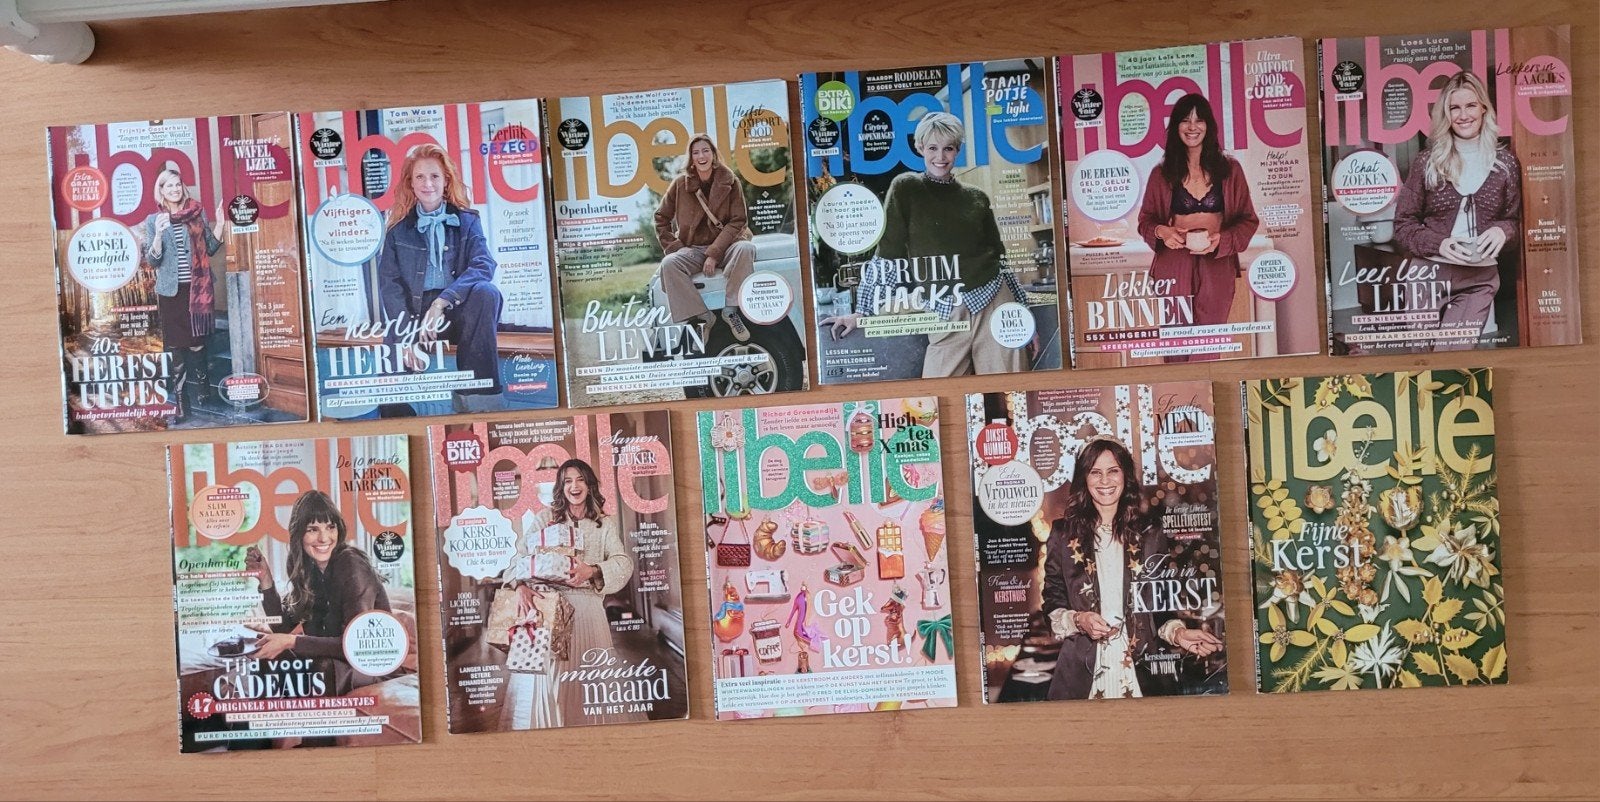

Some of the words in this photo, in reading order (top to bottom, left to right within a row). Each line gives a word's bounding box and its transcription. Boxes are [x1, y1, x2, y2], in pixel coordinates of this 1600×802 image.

[1257, 52, 1280, 61] Ultra
[1410, 46, 1426, 54] geen
[1428, 45, 1440, 53] tijd
[1245, 60, 1294, 73] COMFORT
[1496, 63, 1540, 76] Lekkers
[895, 70, 941, 81] RODDELEN
[981, 74, 1031, 90] STAMP
[1514, 73, 1566, 86] LAAGJES
[818, 90, 850, 98] EXTRA
[987, 87, 1028, 101] POTJE
[1245, 84, 1293, 100] CURRY
[819, 98, 851, 110] DIK!
[1006, 101, 1030, 115] light
[411, 108, 437, 116] Waes
[733, 105, 764, 118] Herfst
[732, 116, 782, 129] COMFORT
[864, 123, 888, 132] Citytrip
[488, 123, 527, 141] Eerlijk
[744, 126, 772, 138] FOOD
[858, 130, 895, 141] KOPENHAGEN
[234, 145, 271, 159] WAFEL
[480, 140, 537, 154] GEZEGD
[246, 158, 276, 171] IJZER
[1348, 159, 1380, 173] Schat
[1080, 170, 1091, 179] DE
[1094, 167, 1129, 178] ERFENIS
[1342, 171, 1388, 186] ZOEKEN
[323, 208, 371, 217] Vijftigers
[560, 202, 618, 215] Openhartig
[329, 228, 369, 236] vlinders
[78, 239, 128, 252] KAPSEL
[77, 251, 130, 265] trendgids
[861, 254, 962, 286] OPRUIM
[1338, 259, 1389, 286] Leer,
[1396, 259, 1440, 282] lees
[1102, 271, 1176, 299] Lekker
[873, 283, 966, 315] HACKS
[1372, 280, 1452, 313] LEEF!
[582, 295, 671, 334] Buiten
[1001, 310, 1023, 319] FACE
[1087, 295, 1194, 330] BINNEN
[870, 317, 917, 325] woonideeën
[905, 323, 949, 333] opgeruimd
[1001, 319, 1024, 328] YOGA
[321, 309, 347, 326] Een
[345, 311, 451, 349] heerlijke
[1110, 331, 1158, 340] LINGERIE
[1170, 327, 1194, 336] rood,
[1232, 324, 1272, 332] bordeaux
[91, 337, 121, 354] 40x
[597, 324, 706, 362] LEVEN
[327, 340, 451, 377] HERFST
[72, 352, 173, 382] HERFST
[588, 383, 648, 392] BINNENKIJKEN
[672, 378, 707, 386] buitenhuis
[79, 379, 168, 409] UITJES
[329, 399, 344, 407] Zelf
[368, 393, 449, 403] HERFSTDECORATIES
[76, 409, 147, 420] budgetvriendelijk
[149, 409, 159, 418] op
[160, 407, 177, 416] pad
[878, 412, 916, 432] High
[1155, 412, 1205, 434] MENU
[1248, 371, 1495, 483] libelle
[599, 429, 660, 445] Samen
[909, 430, 934, 440] tea
[986, 429, 1007, 442] DIKSTE
[447, 440, 480, 449] EXTRA
[620, 444, 640, 452] alles
[880, 439, 929, 454] X-mas
[984, 441, 1011, 455] NUMMER
[336, 455, 350, 469] De
[353, 455, 364, 466] 10
[367, 453, 402, 465] mooiste
[447, 448, 480, 461] DIK!
[611, 452, 656, 466] LEUKER
[698, 401, 939, 514] libelle
[353, 468, 391, 479] KERST
[344, 479, 401, 492] MARKTEN
[985, 484, 1038, 500] Vrouwen
[988, 501, 996, 509] in
[998, 500, 1011, 509] het
[1013, 500, 1036, 508] nieuws
[199, 510, 236, 518] NALATEN
[1162, 513, 1211, 528] SPELLETJESTEST
[462, 525, 498, 538] KERST
[1298, 522, 1349, 547] Fijne
[450, 536, 511, 552] KOOKBOEK
[1271, 538, 1365, 572] Kerst
[179, 559, 240, 570] Openhartig
[1142, 554, 1177, 579] Zin
[1181, 568, 1196, 578] in
[814, 586, 876, 617] Gek
[994, 591, 1026, 603] KERSTHUIS
[1131, 578, 1216, 614] KERST
[356, 628, 395, 639] LEKKER
[834, 615, 870, 646] op
[358, 638, 394, 648] BREIEN
[579, 648, 618, 668] De
[822, 634, 914, 668] kerst!
[1144, 653, 1180, 661] Kerstshoppen
[223, 659, 260, 675] Tijd
[268, 659, 312, 670] voor
[560, 658, 657, 682] mooiste
[1151, 663, 1158, 674] IN
[1160, 662, 1175, 674] YORK
[214, 672, 326, 700] CADEAUS
[583, 668, 671, 705] maand
[752, 678, 781, 687] inspiratie
[190, 697, 213, 712] 47
[215, 701, 265, 712] ORIGINELE
[268, 699, 316, 710] DUURZAME
[319, 697, 374, 708] PRESENTJES
[583, 707, 602, 715] VAN
[607, 705, 624, 713] HET
[628, 703, 653, 712] JAAR
